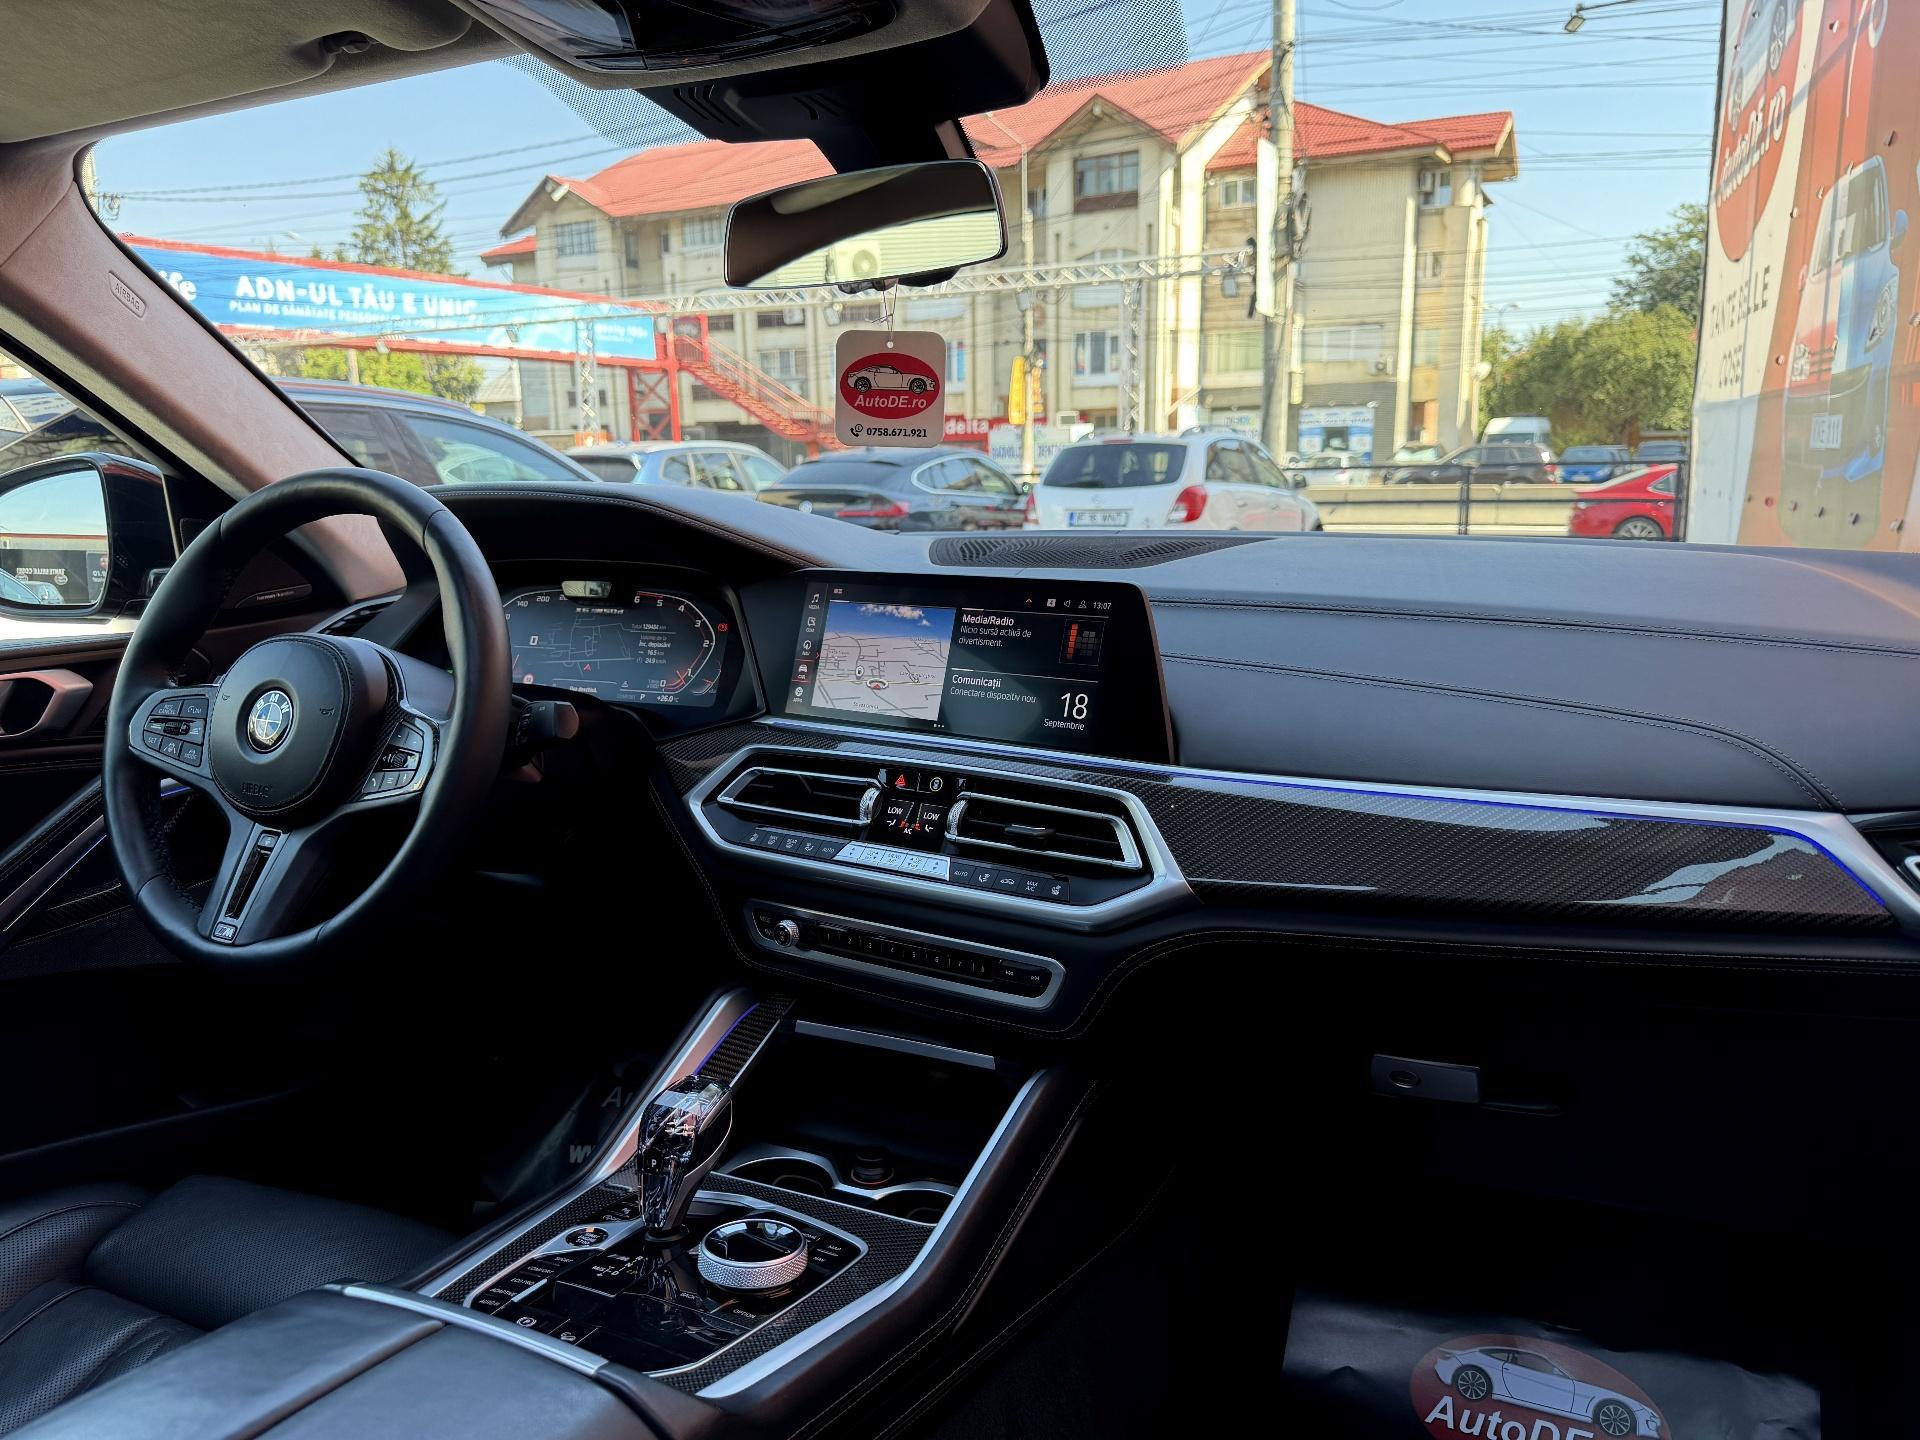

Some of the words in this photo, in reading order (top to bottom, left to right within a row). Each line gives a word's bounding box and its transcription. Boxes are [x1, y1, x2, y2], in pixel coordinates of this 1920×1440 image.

[115, 283, 140, 311] AIRBAG
[236, 275, 343, 306] ADN-UL
[347, 283, 395, 312] TĂU
[402, 292, 416, 314] E
[229, 300, 261, 313] PLAN
[263, 303, 279, 315] DE
[854, 394, 926, 408] AutoDE.ro
[866, 427, 928, 437] 0758.671.921
[945, 419, 989, 434] delta
[656, 599, 663, 607] 5
[1093, 601, 1112, 610] 13:07
[694, 619, 701, 627] 3
[962, 614, 1015, 626] Media/Radio
[960, 625, 978, 634] Nicio
[979, 627, 998, 636] sursă
[999, 627, 1021, 637] activă
[1021, 629, 1032, 638] de
[529, 635, 539, 645] 0
[958, 637, 1003, 647] divertisment.
[952, 674, 1001, 689] Comunicații
[950, 687, 986, 698] Conectare
[986, 690, 1021, 702] dispozitiv
[1021, 694, 1037, 703] nou
[256, 693, 290, 714] BMW
[1061, 692, 1089, 720] 18
[1043, 718, 1085, 731] Septembrie
[887, 806, 904, 815] LOW
[923, 812, 940, 821] LOW
[680, 1292, 696, 1300] BACK
[732, 1308, 757, 1319] OPTION
